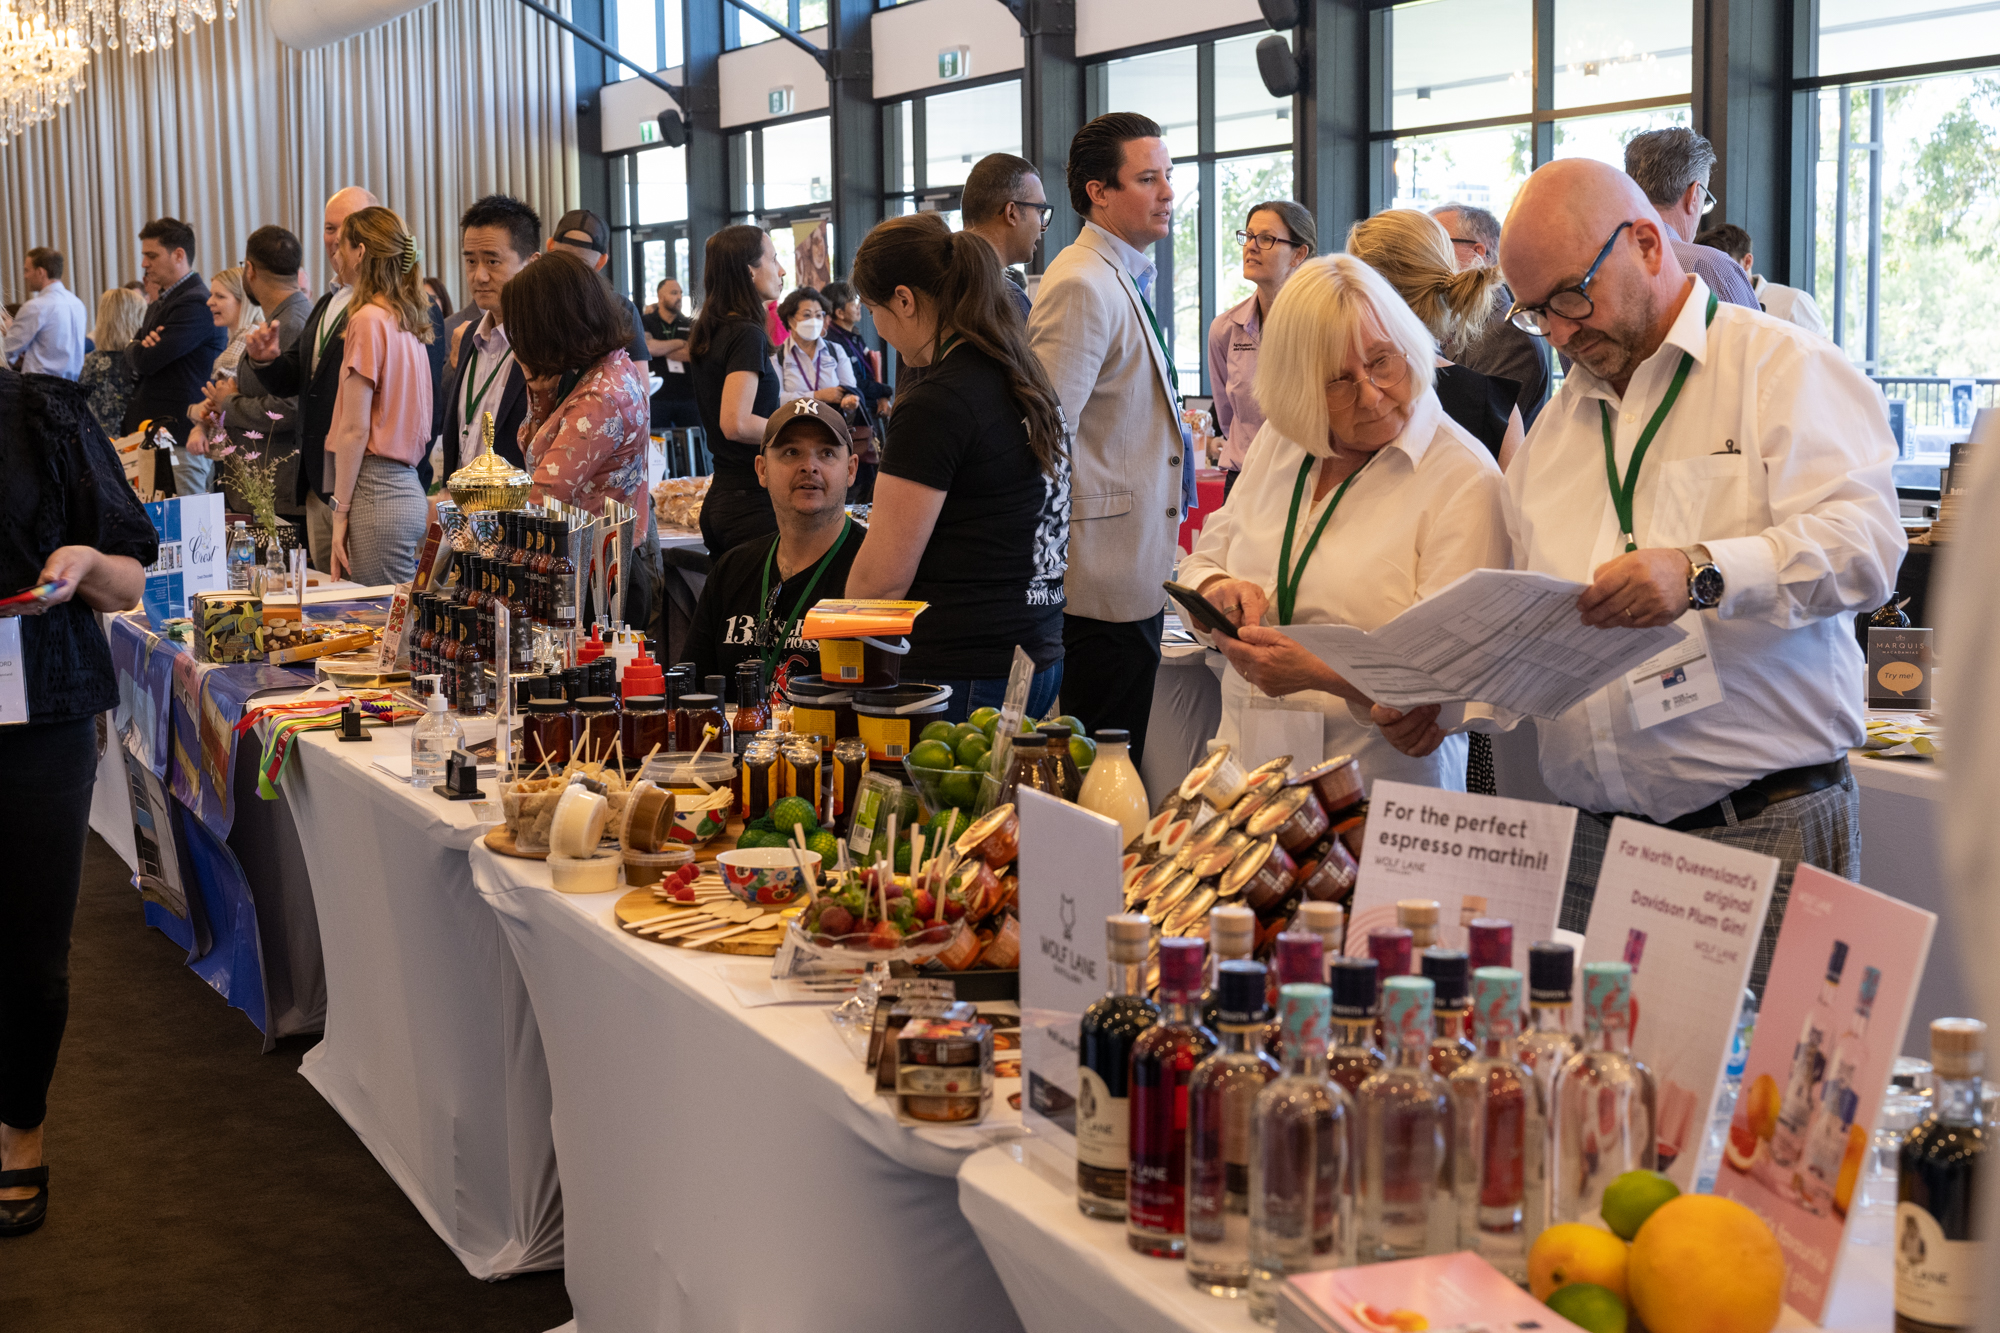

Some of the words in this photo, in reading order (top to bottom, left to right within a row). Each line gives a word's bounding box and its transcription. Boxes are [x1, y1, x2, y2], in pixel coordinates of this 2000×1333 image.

[794, 398, 819, 415] NY
[188, 535, 217, 565] Crest
[1025, 589, 1049, 605] HOT
[723, 614, 754, 644] 13
[1885, 673, 1897, 681] Try
[1384, 801, 1415, 821] For
[1421, 805, 1450, 826] the
[1455, 813, 1528, 838] perfect
[1374, 855, 1401, 869] WOLF
[1402, 859, 1427, 873] LANE
[1379, 830, 1462, 856] espresso
[1467, 844, 1549, 871] martini!
[1619, 840, 1638, 857] Far
[1640, 847, 1674, 868] North
[1676, 855, 1757, 891] Queensland's
[1631, 889, 1686, 919] Davidson
[1687, 906, 1719, 928] Plum
[1720, 917, 1748, 937] Gin!
[1703, 890, 1754, 913] original
[1040, 935, 1069, 963] WOLF
[1069, 950, 1097, 980] LANE
